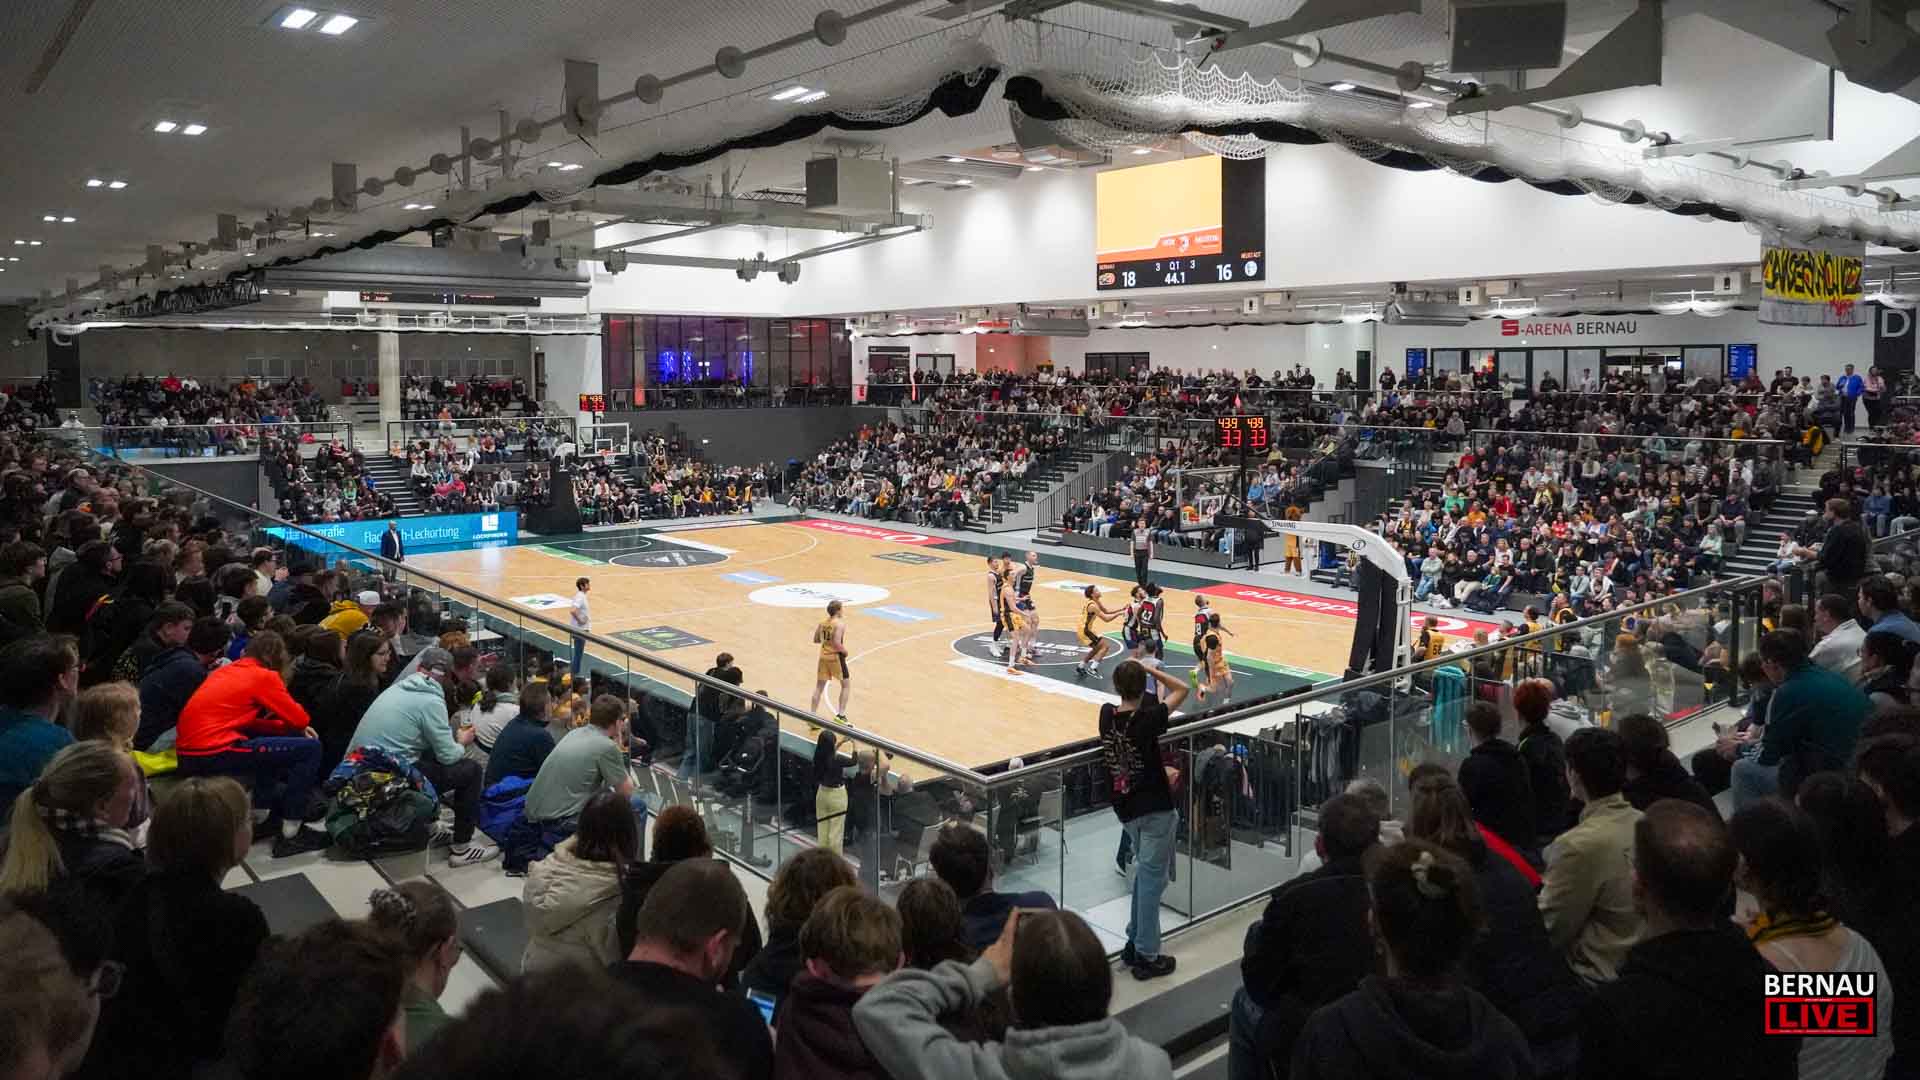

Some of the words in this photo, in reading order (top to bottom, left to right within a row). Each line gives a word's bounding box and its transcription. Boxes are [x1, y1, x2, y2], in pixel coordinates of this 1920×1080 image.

[1156, 263, 1161, 271] 3
[1190, 260, 1196, 269] 3
[1216, 264, 1232, 281] 16
[1122, 271, 1136, 287] 18
[1164, 272, 1185, 284] 44.1
[1577, 320, 1637, 335] BERNAU
[1881, 309, 1911, 338] D
